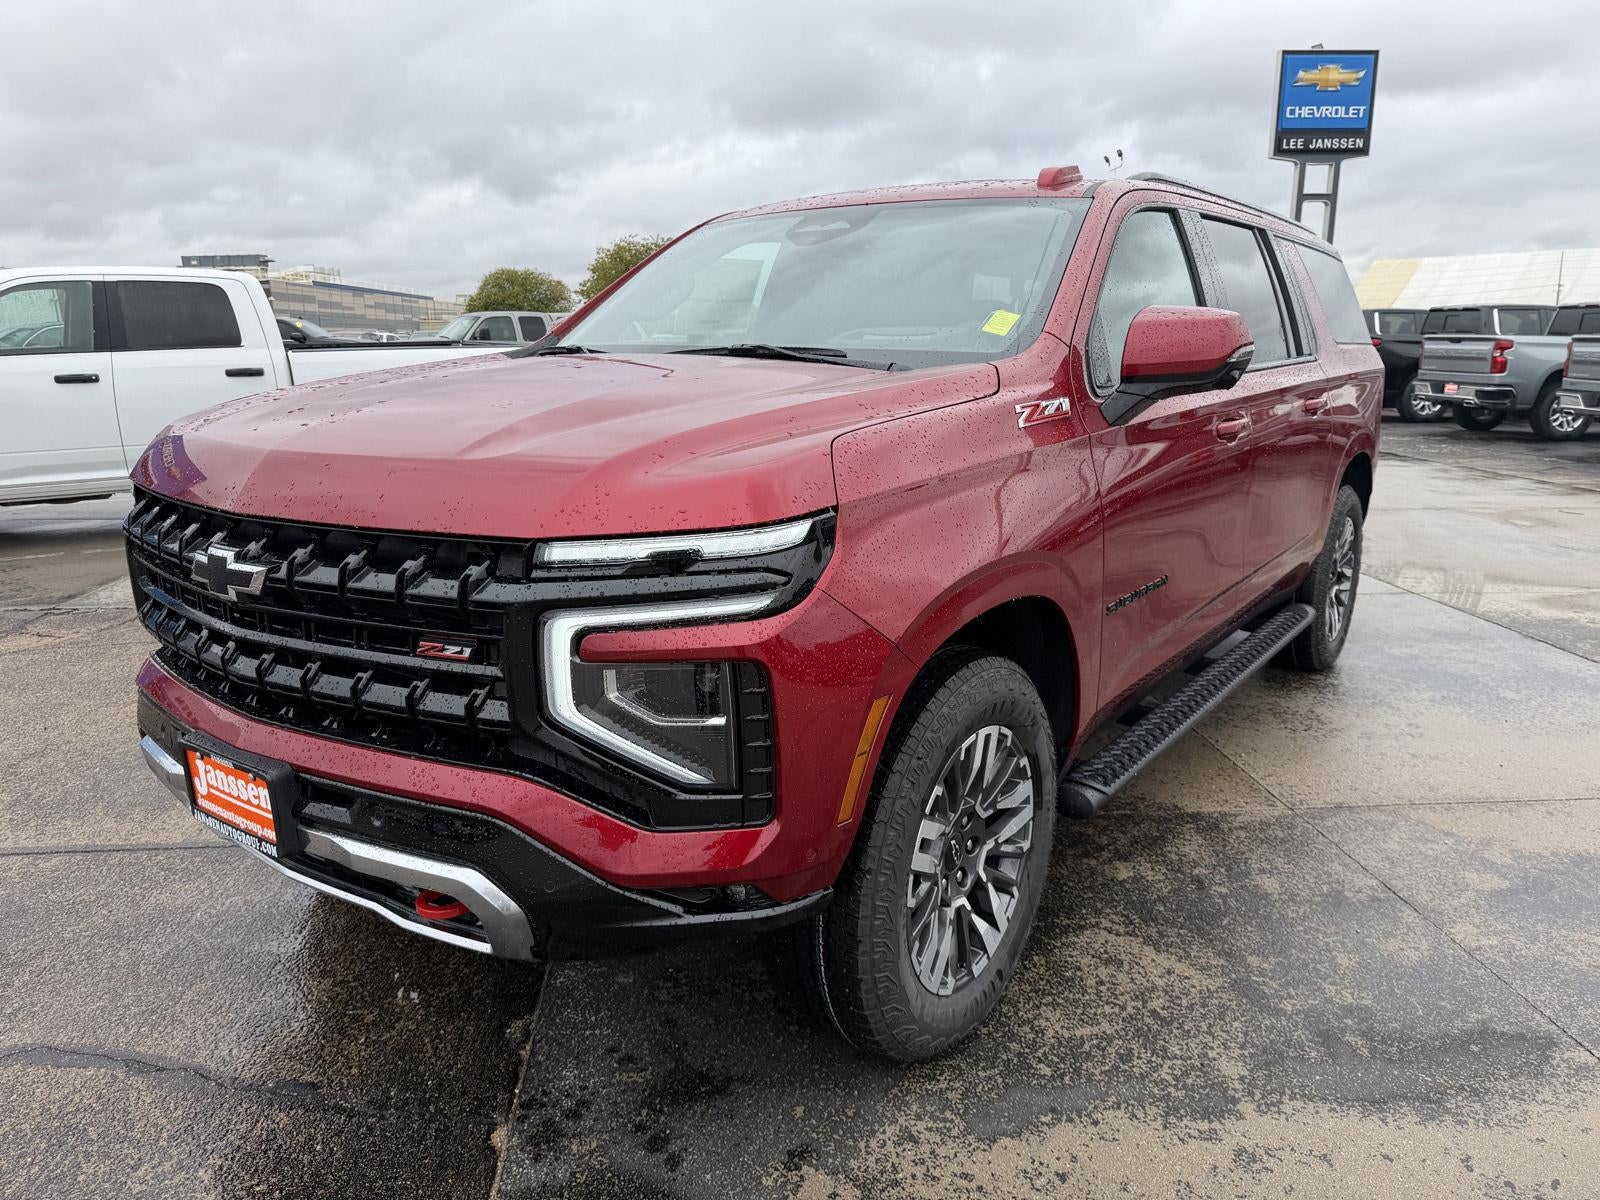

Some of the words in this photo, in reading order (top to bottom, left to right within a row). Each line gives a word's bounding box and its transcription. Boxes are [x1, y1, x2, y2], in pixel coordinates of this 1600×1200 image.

[1285, 106, 1366, 118] CHEVROLET
[1282, 138, 1304, 149] LEE
[1309, 138, 1364, 149] JANSSEN
[1014, 396, 1071, 428] Z71
[416, 641, 472, 661] Z71
